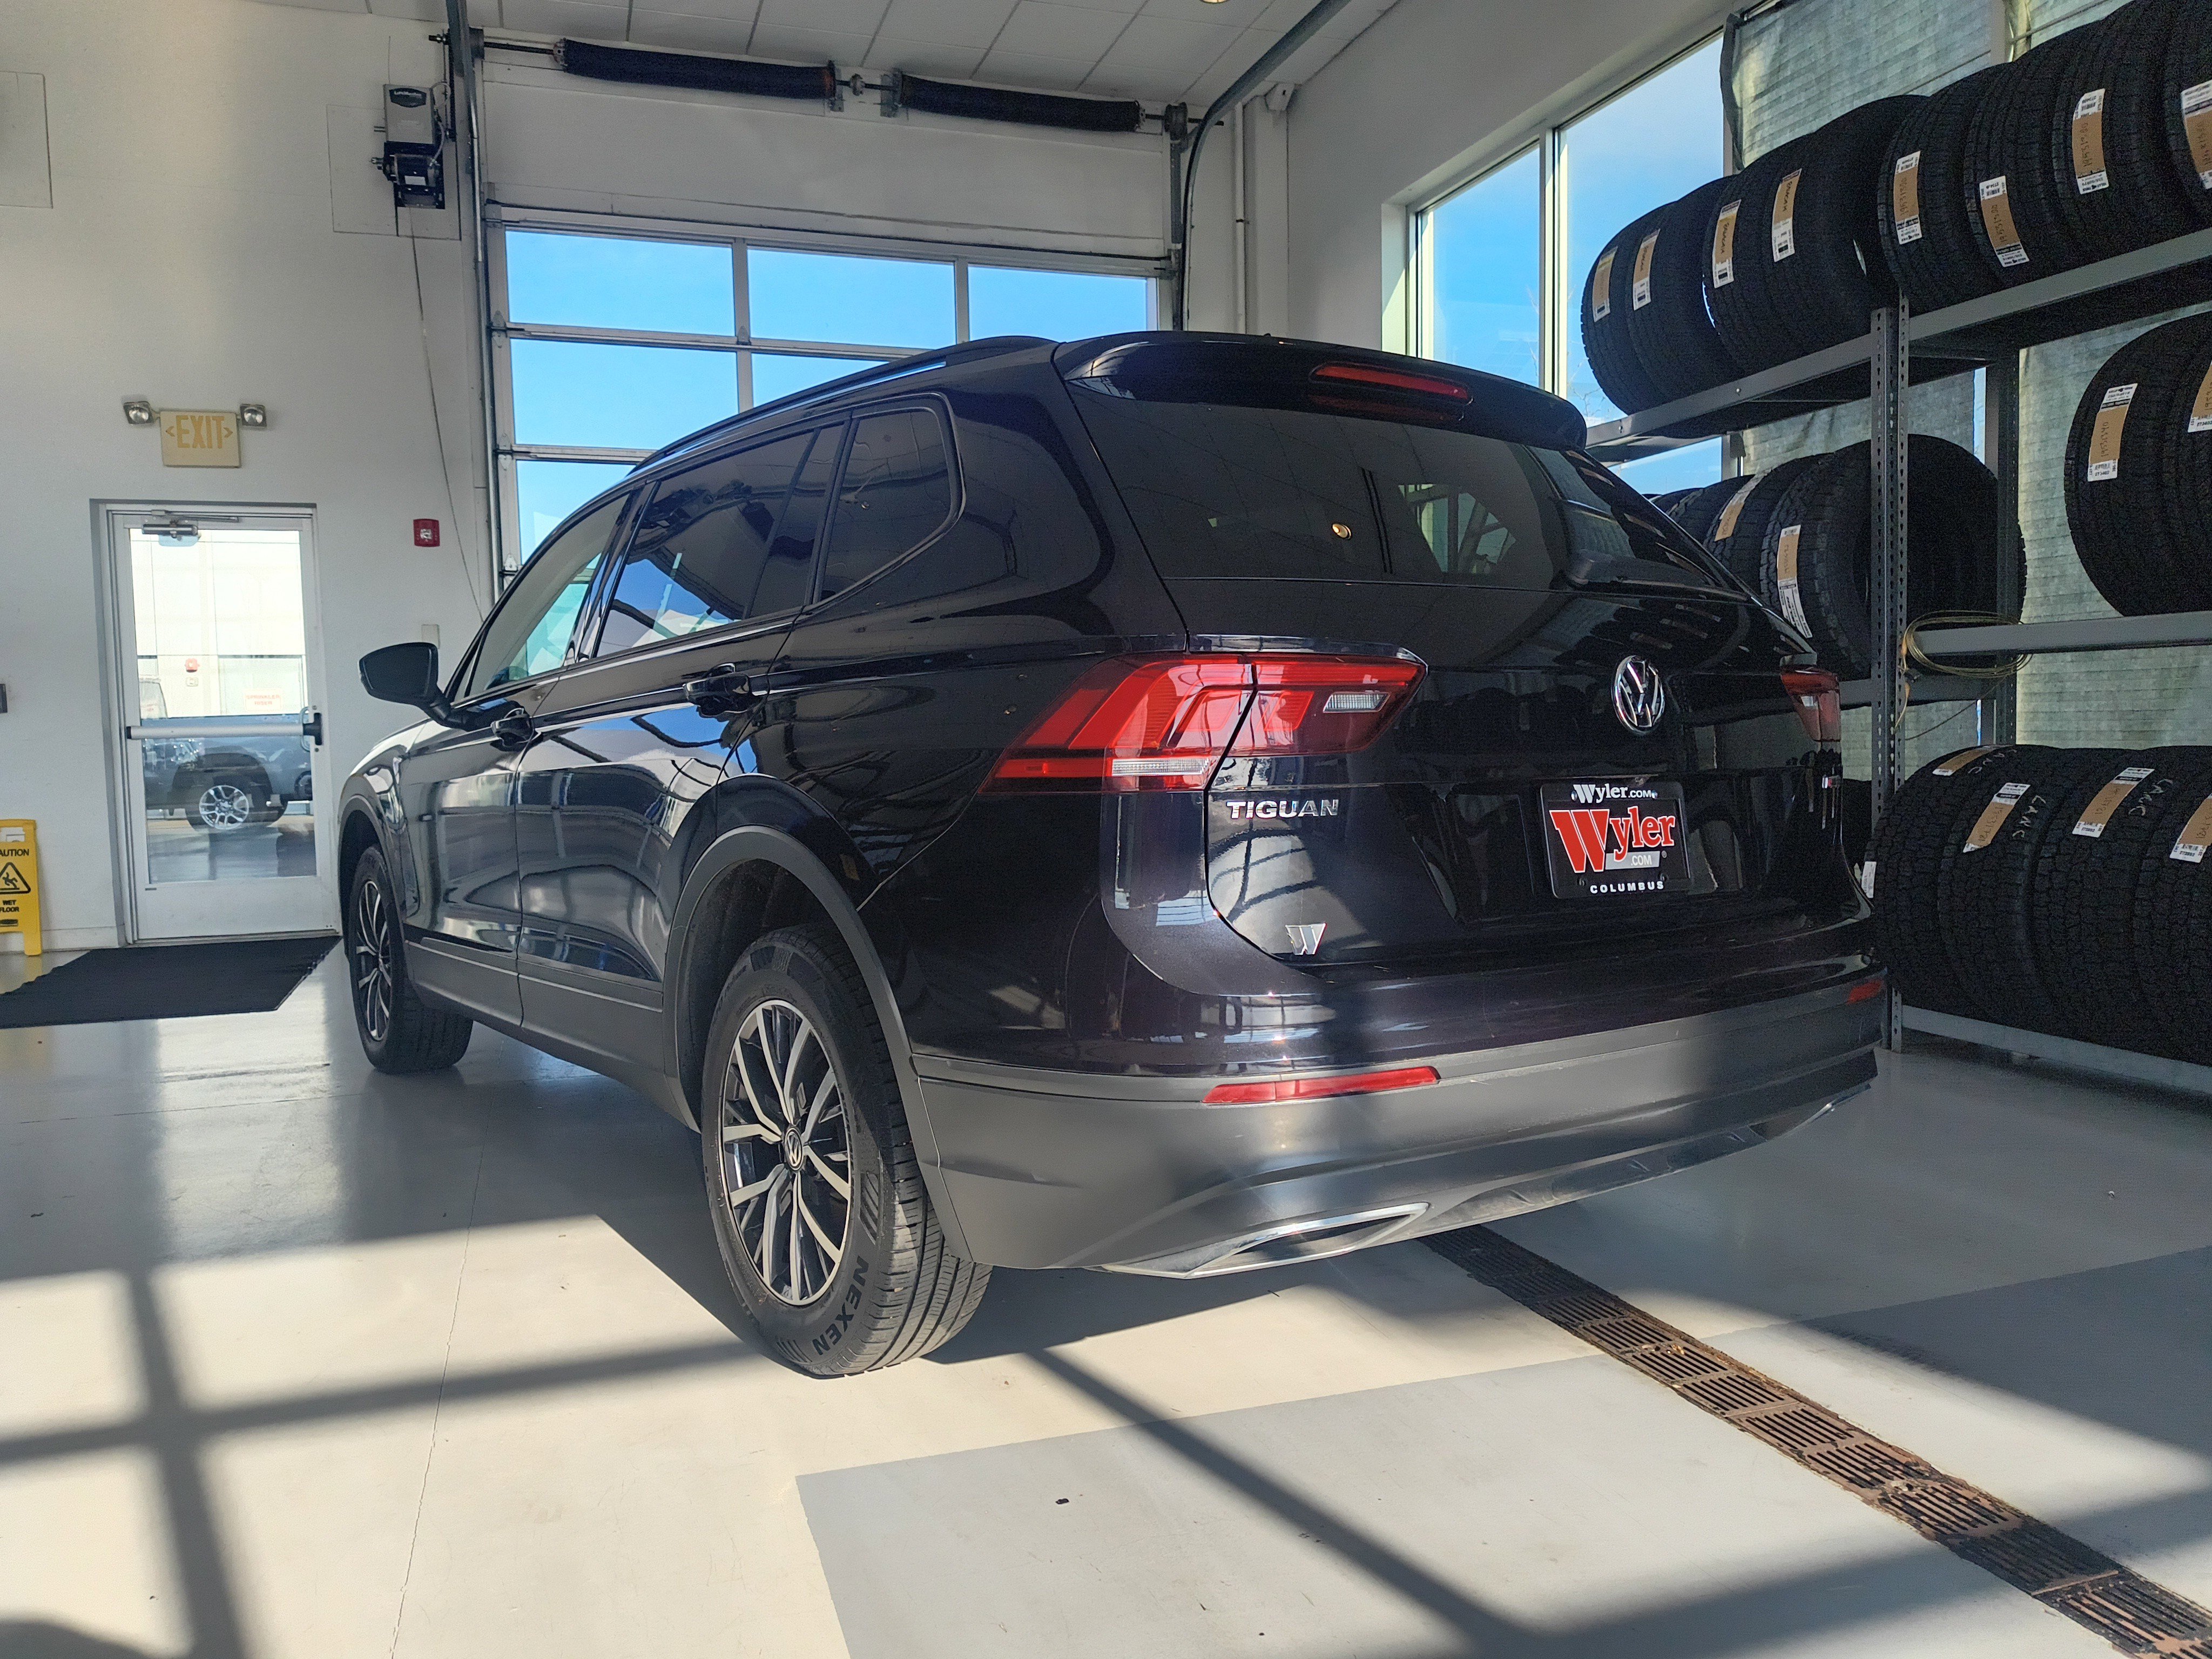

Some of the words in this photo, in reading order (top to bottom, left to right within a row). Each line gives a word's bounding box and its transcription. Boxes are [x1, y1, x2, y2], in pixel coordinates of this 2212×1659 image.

[176, 415, 225, 449] EXIT
[1226, 799, 1339, 819] TIGUAN
[1549, 806, 1676, 873] Wyler
[0, 848, 29, 857] AUTION
[1631, 855, 1653, 866] .COM
[1590, 881, 1664, 894] COLUMBUS
[812, 1255, 870, 1356] NEXEN
